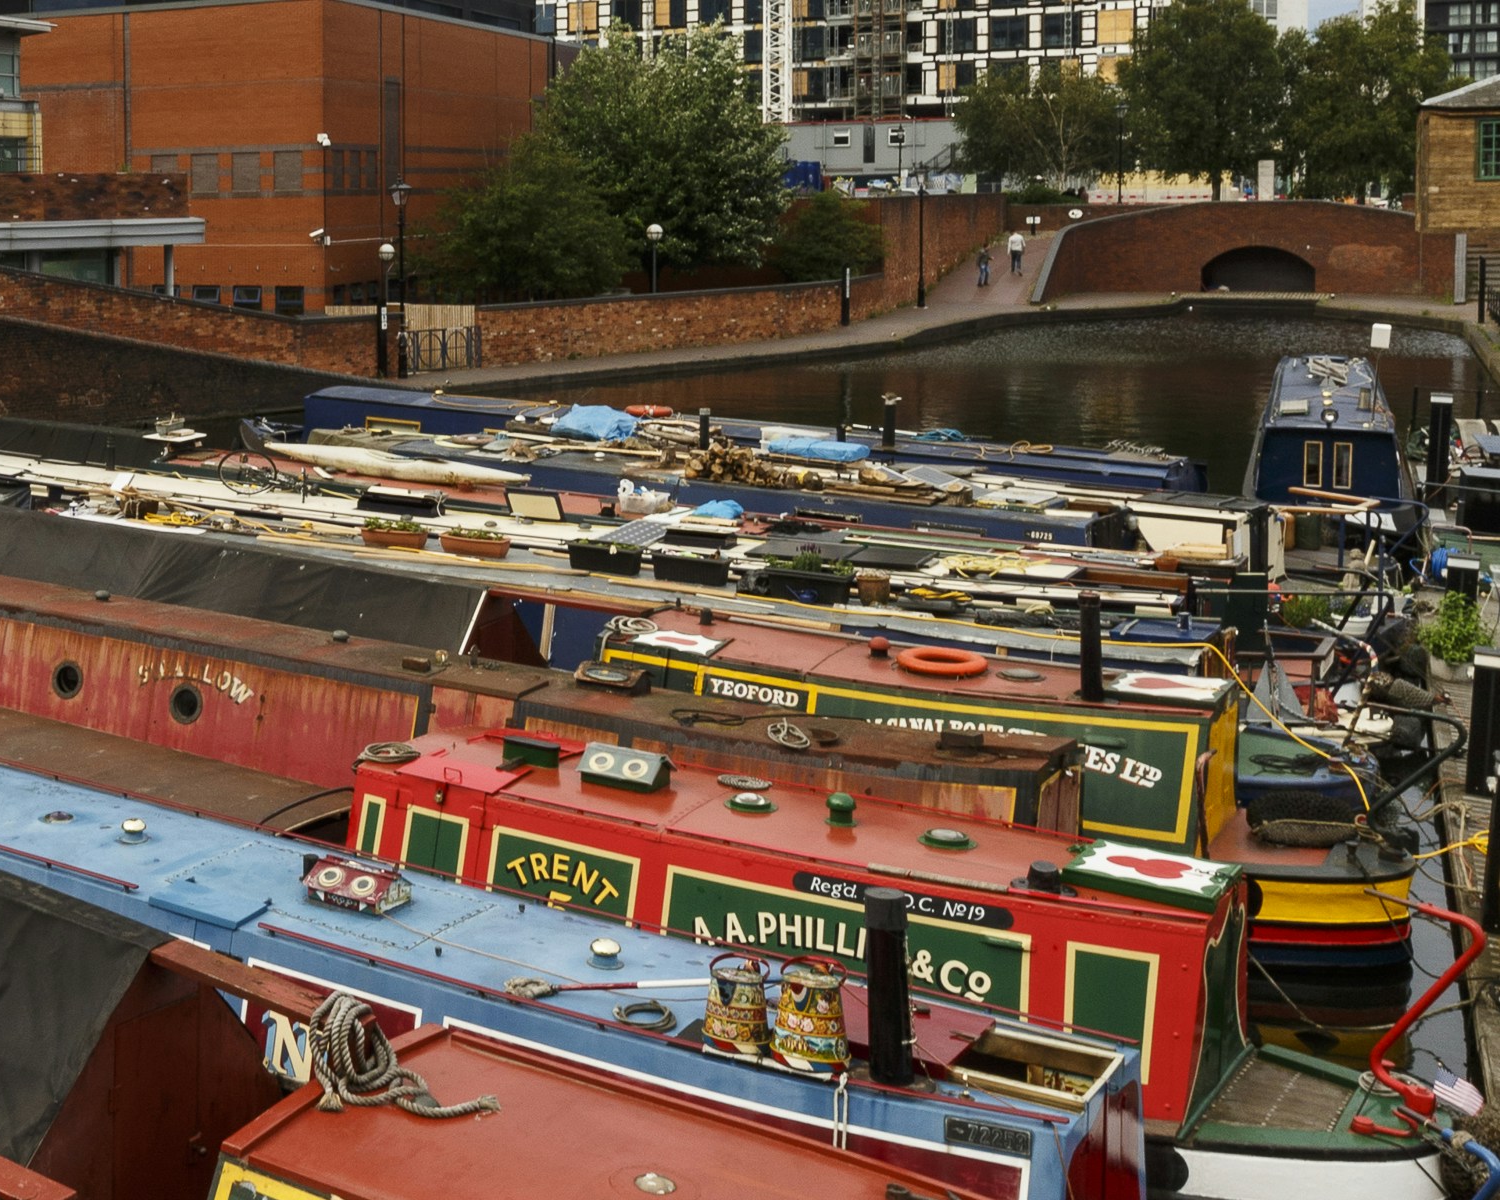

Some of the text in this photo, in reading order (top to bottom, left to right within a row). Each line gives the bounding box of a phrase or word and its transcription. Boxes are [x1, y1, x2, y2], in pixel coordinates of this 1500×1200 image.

[709, 678, 799, 708] YEOFORD
[1119, 757, 1163, 789] LTD
[506, 852, 619, 906] TRENT
[911, 949, 935, 984] &
